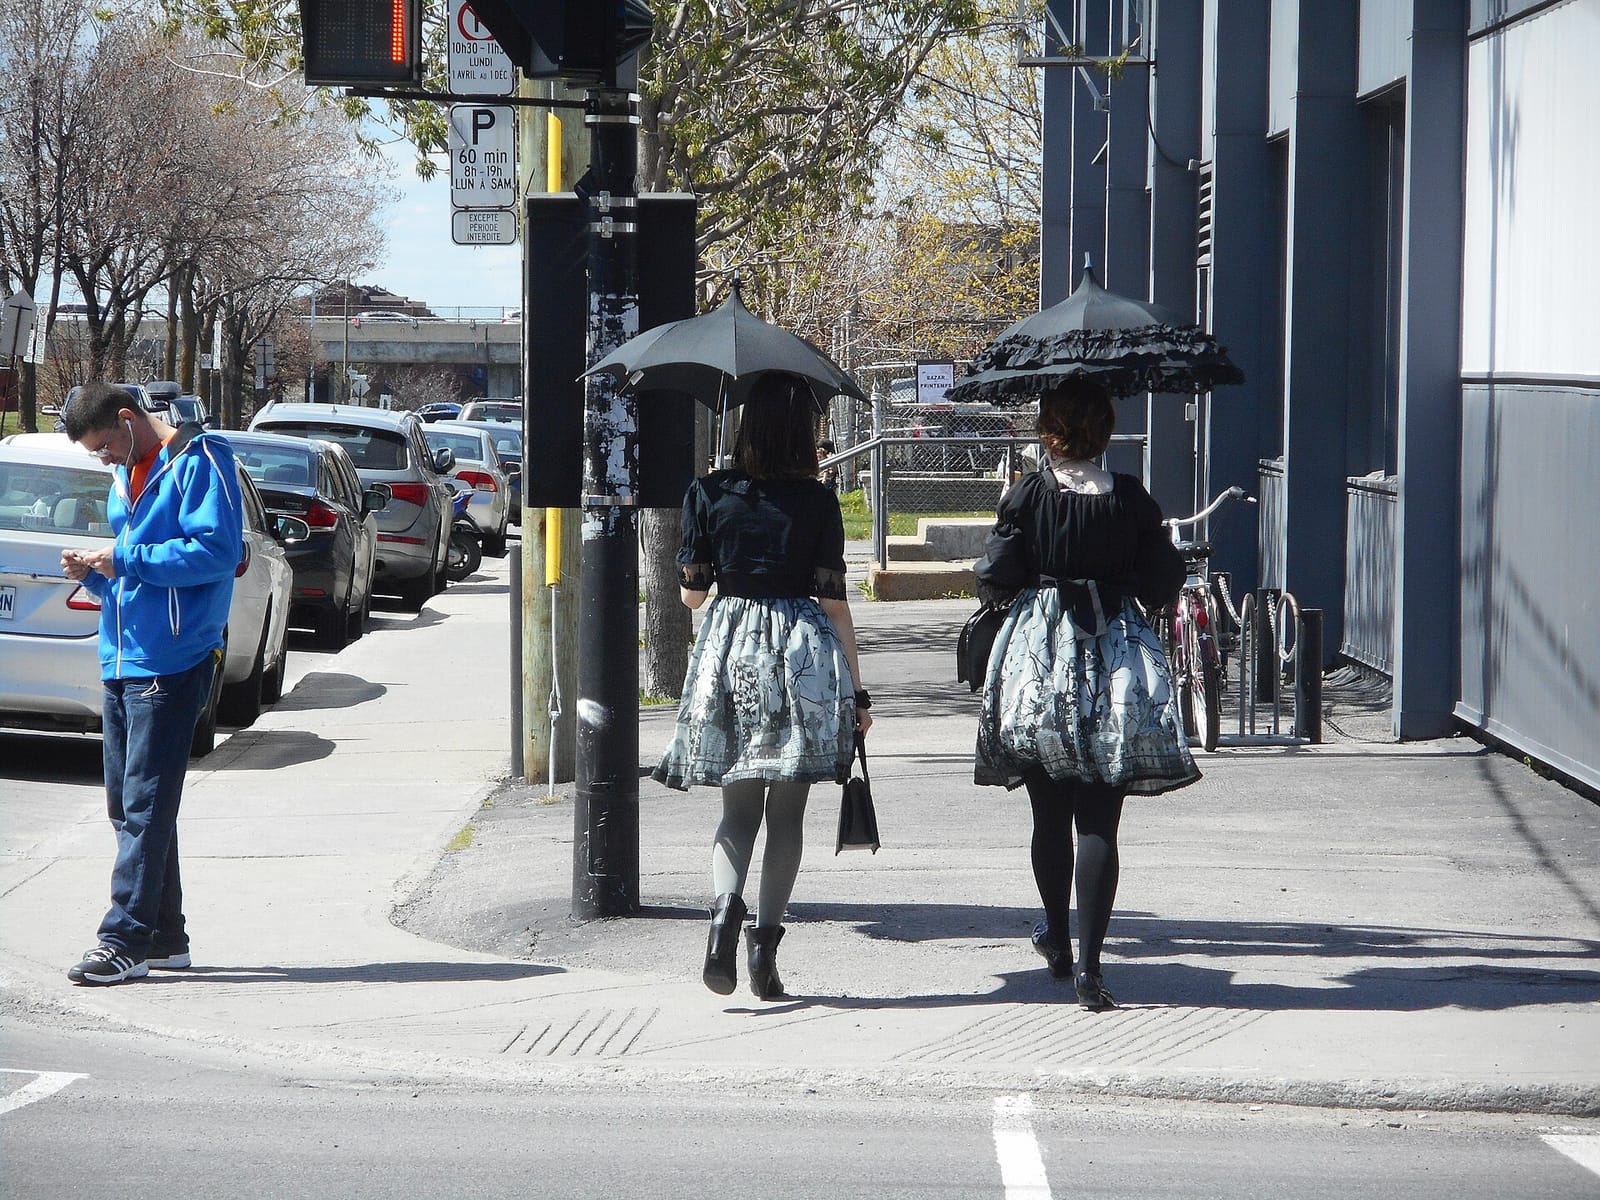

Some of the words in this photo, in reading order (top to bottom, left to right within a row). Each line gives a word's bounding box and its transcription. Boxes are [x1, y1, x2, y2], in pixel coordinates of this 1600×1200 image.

[452, 42, 477, 54] 10h30
[469, 57, 493, 67] LUNDI
[457, 70, 476, 79] AVRIL
[472, 109, 496, 145] P
[459, 149, 476, 164] 60
[484, 148, 507, 163] min
[464, 165, 476, 177] 8h
[487, 165, 502, 176] 19h
[455, 178, 474, 190] LUN
[491, 178, 512, 190] SAM
[467, 233, 501, 241] INTERDITE
